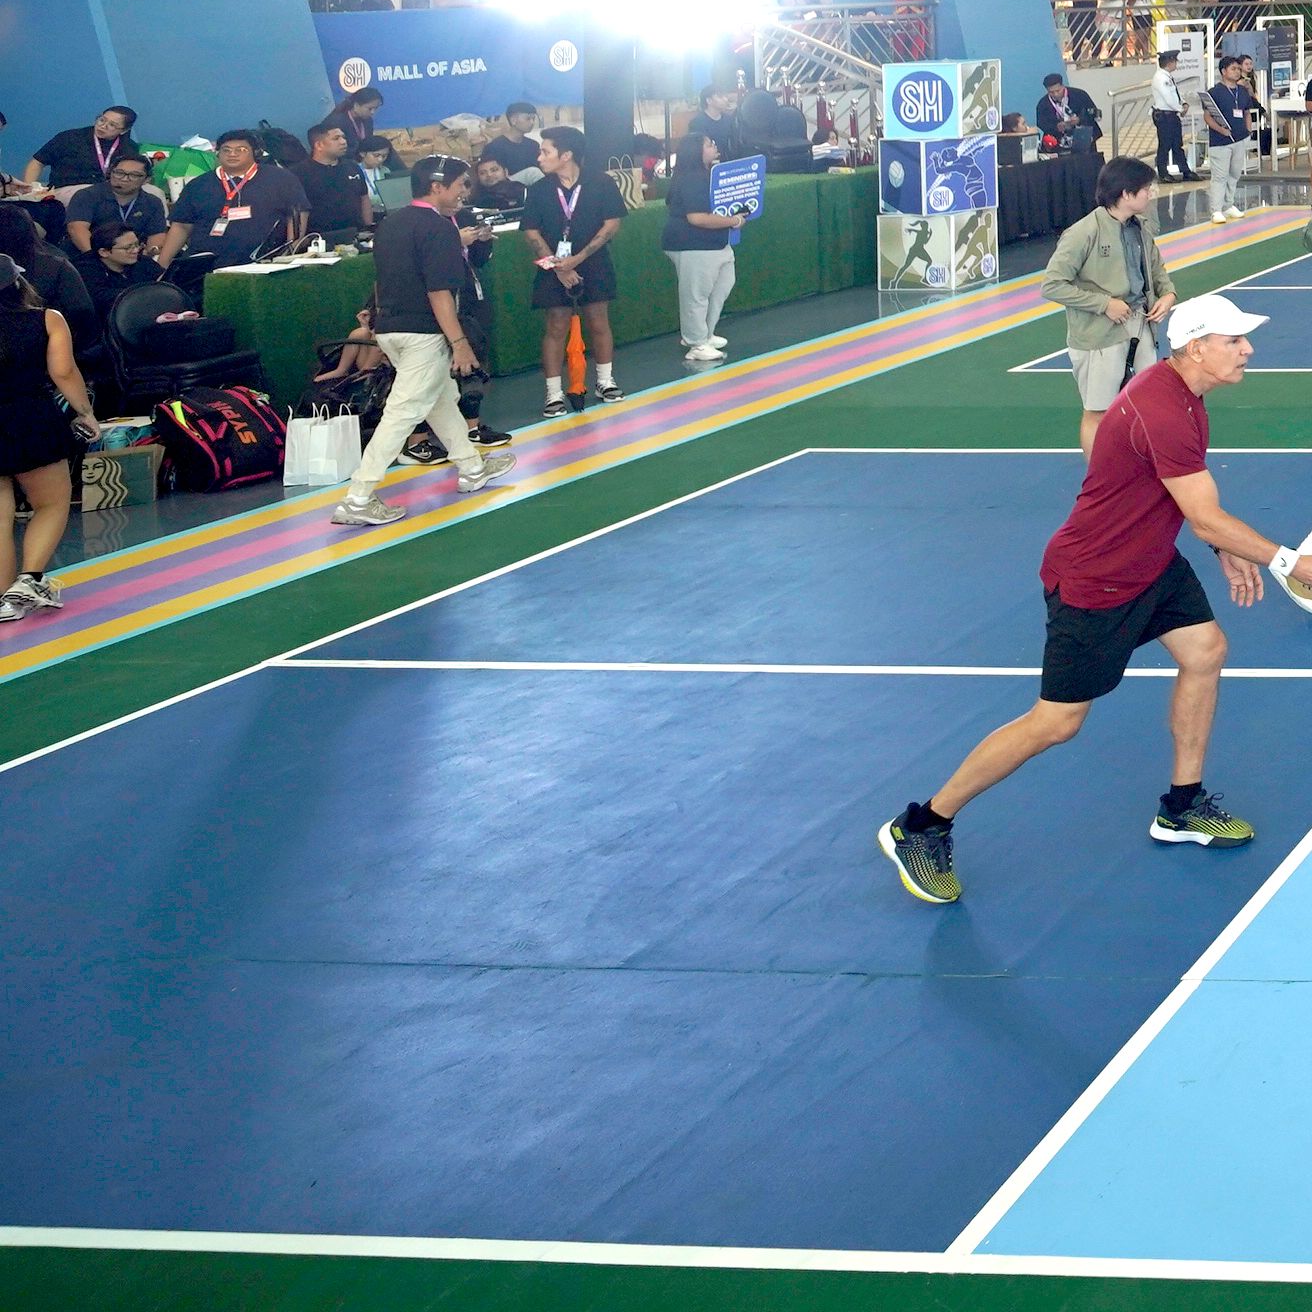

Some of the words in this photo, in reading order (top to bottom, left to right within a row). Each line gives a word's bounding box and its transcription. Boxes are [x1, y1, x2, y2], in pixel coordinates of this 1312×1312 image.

[343, 63, 366, 87] SM
[377, 64, 423, 82] MALL
[427, 62, 449, 78] OF
[451, 57, 488, 76] ASIA
[900, 80, 943, 123] SM
